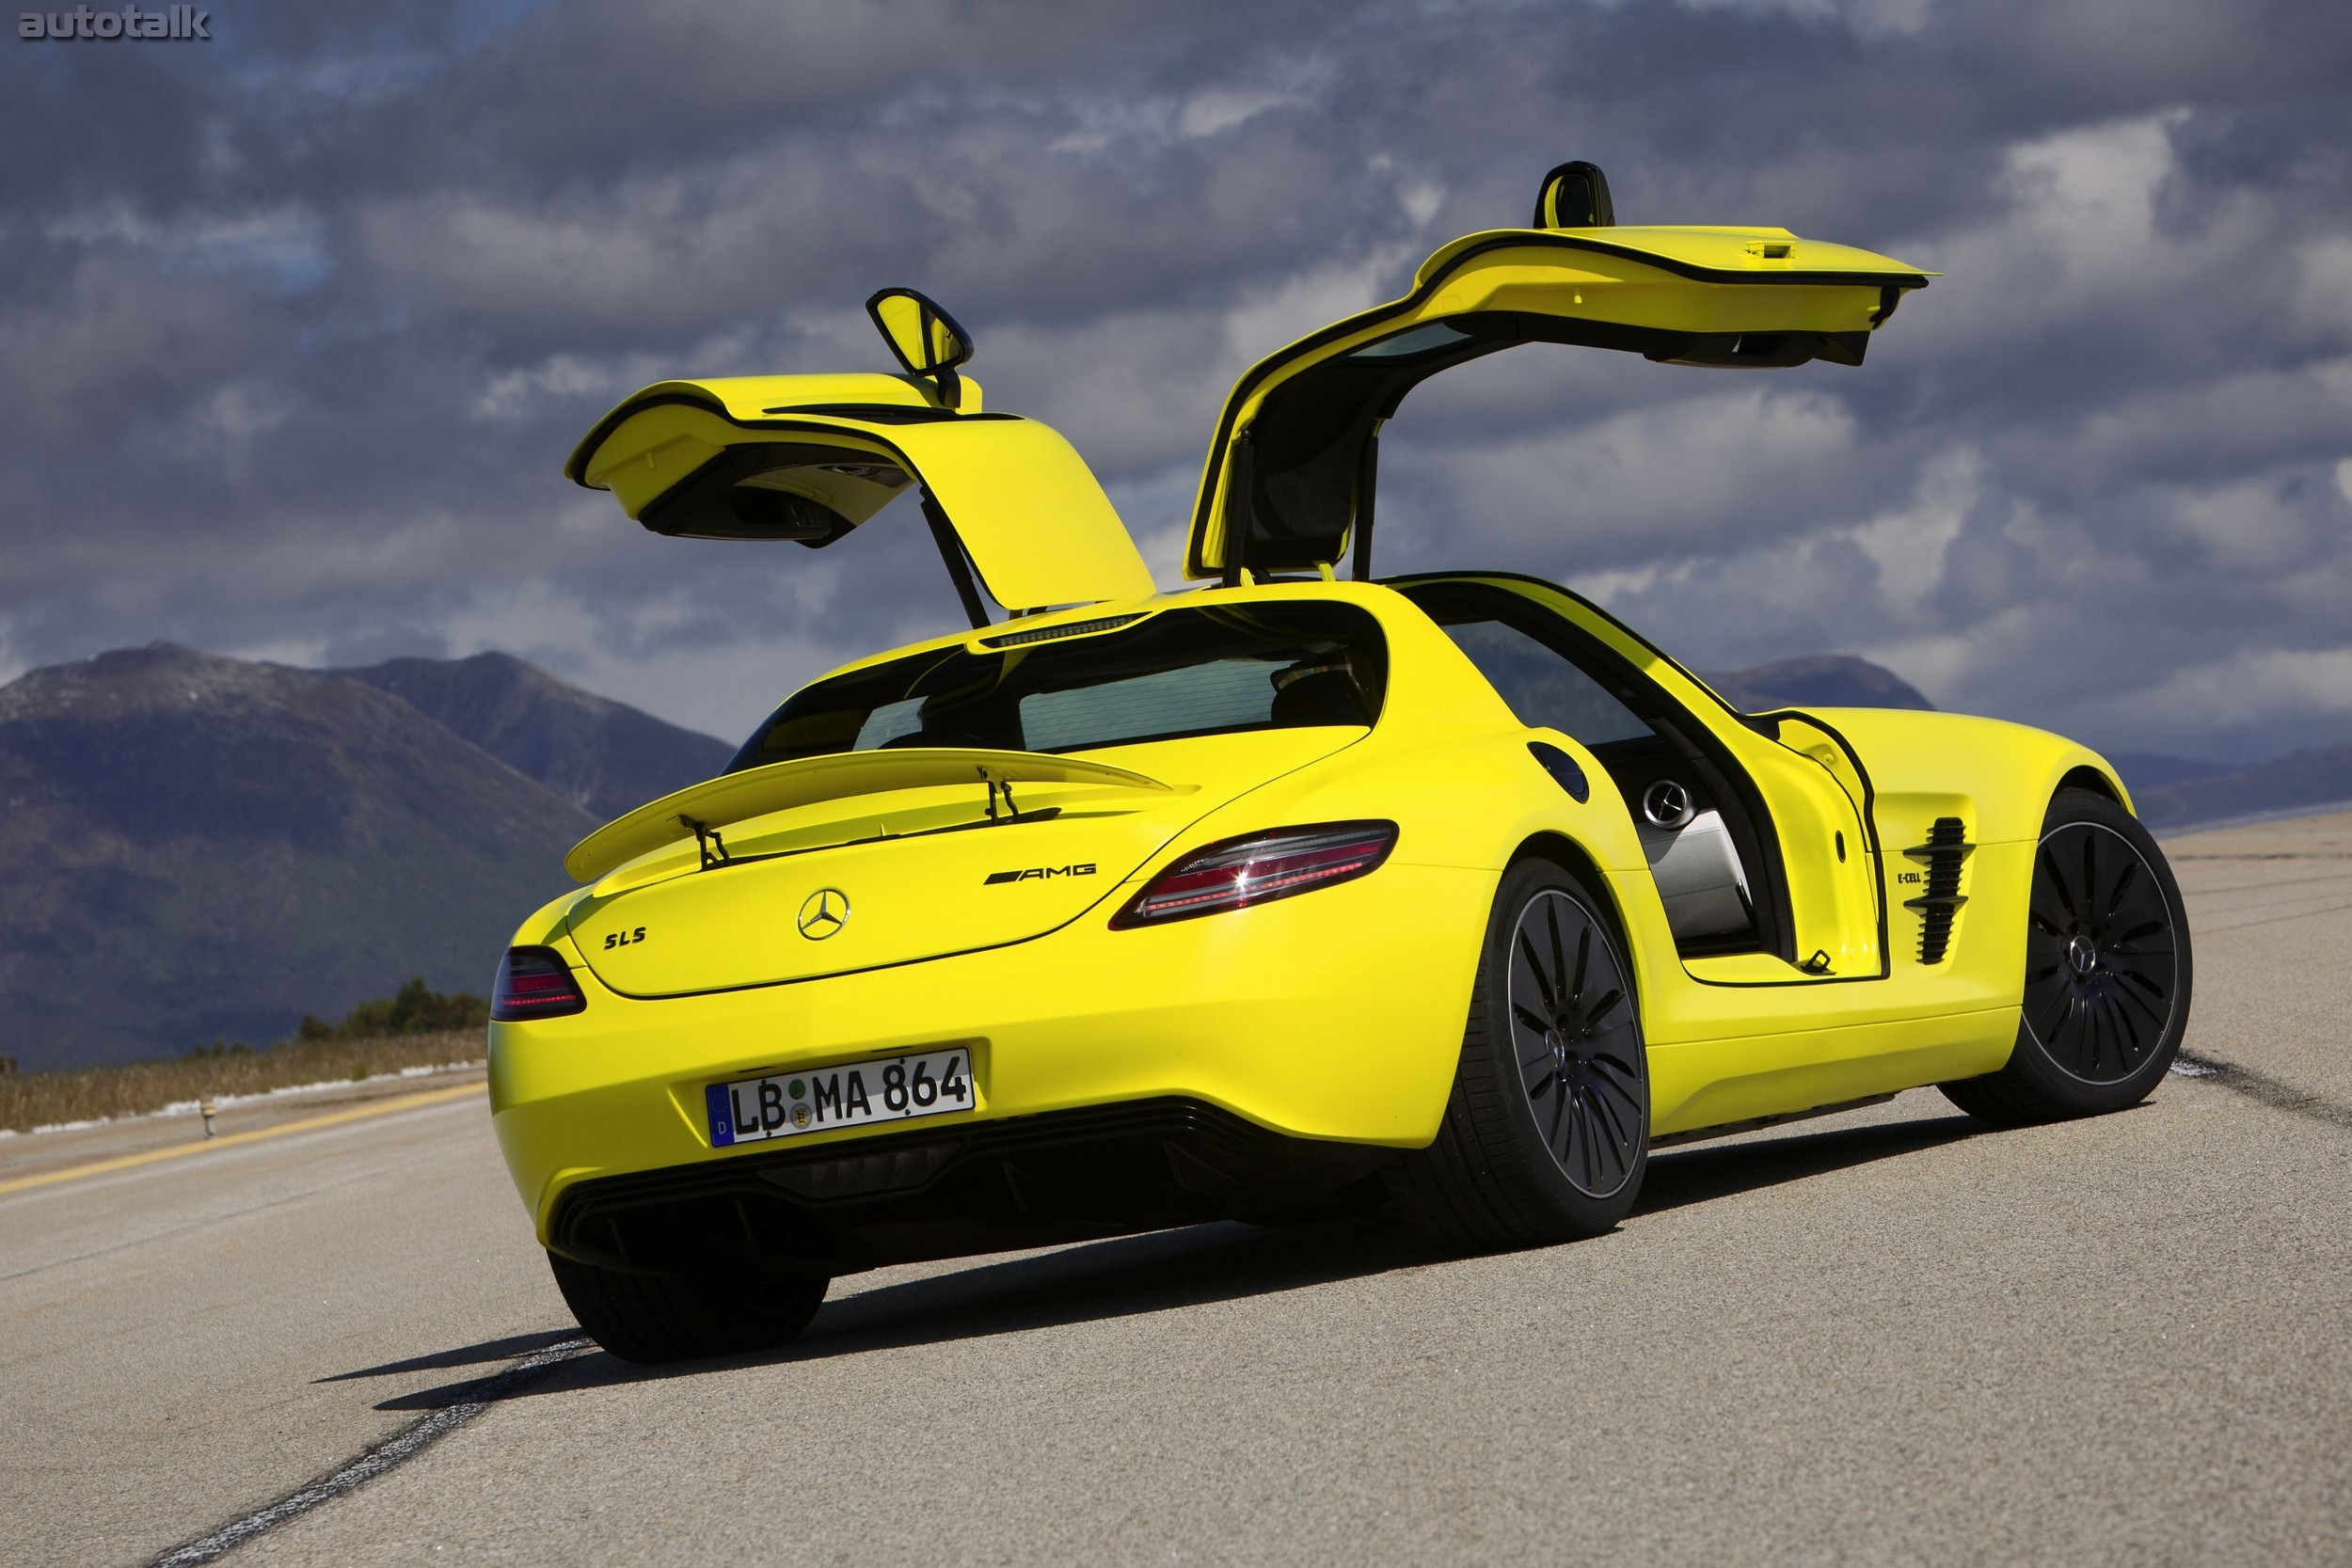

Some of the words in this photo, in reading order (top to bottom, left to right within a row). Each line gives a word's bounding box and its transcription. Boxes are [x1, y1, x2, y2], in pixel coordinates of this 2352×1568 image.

[1018, 863, 1097, 881] AMG
[1898, 872, 1921, 884] E-CELL
[603, 927, 646, 950] SLS
[731, 1084, 787, 1135] LB
[812, 1070, 872, 1122] MA
[882, 1056, 967, 1112] 864
[718, 1121, 726, 1134] D
